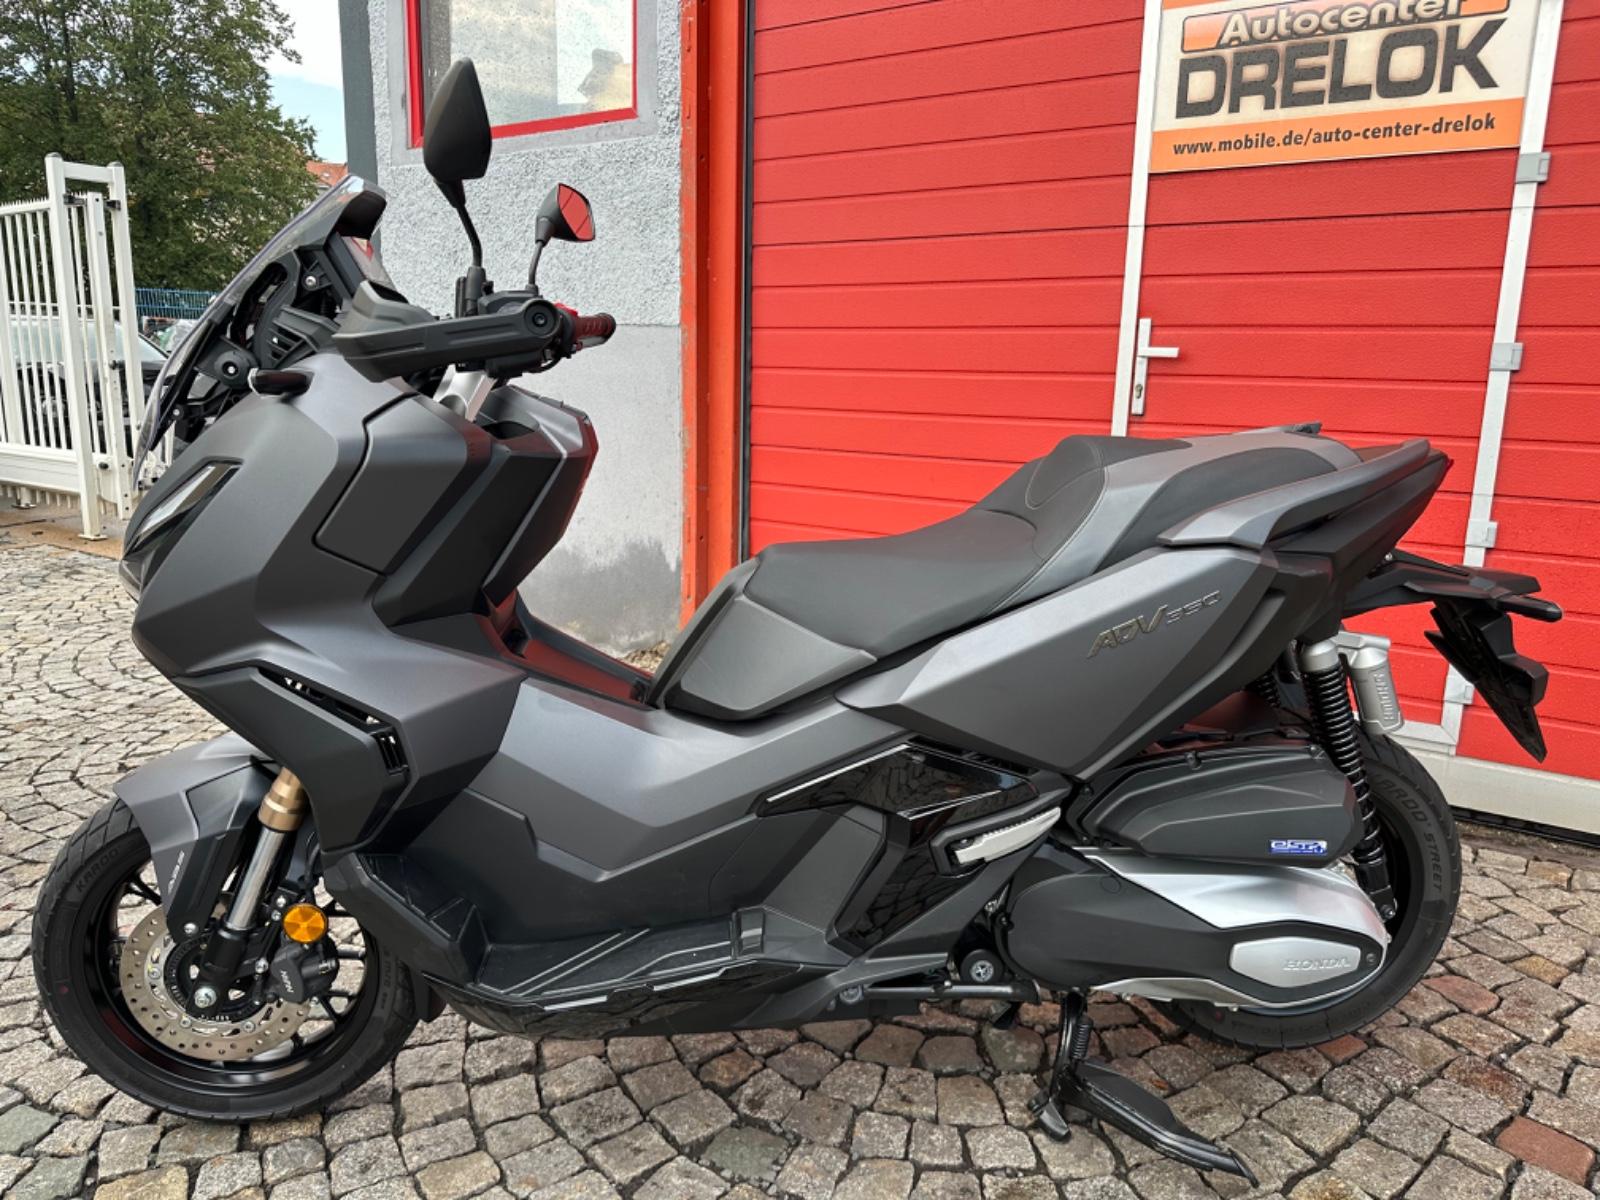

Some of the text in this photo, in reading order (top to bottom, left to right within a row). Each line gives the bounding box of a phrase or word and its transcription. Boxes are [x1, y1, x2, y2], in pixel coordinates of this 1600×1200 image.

[1219, 0, 1462, 46] Autocenter
[1175, 18, 1507, 119] DRELOK
[1173, 112, 1496, 156] www.mobile.de/auto-center-drelok
[76, 847, 121, 893] KAROO
[1281, 957, 1352, 971] HONDA
